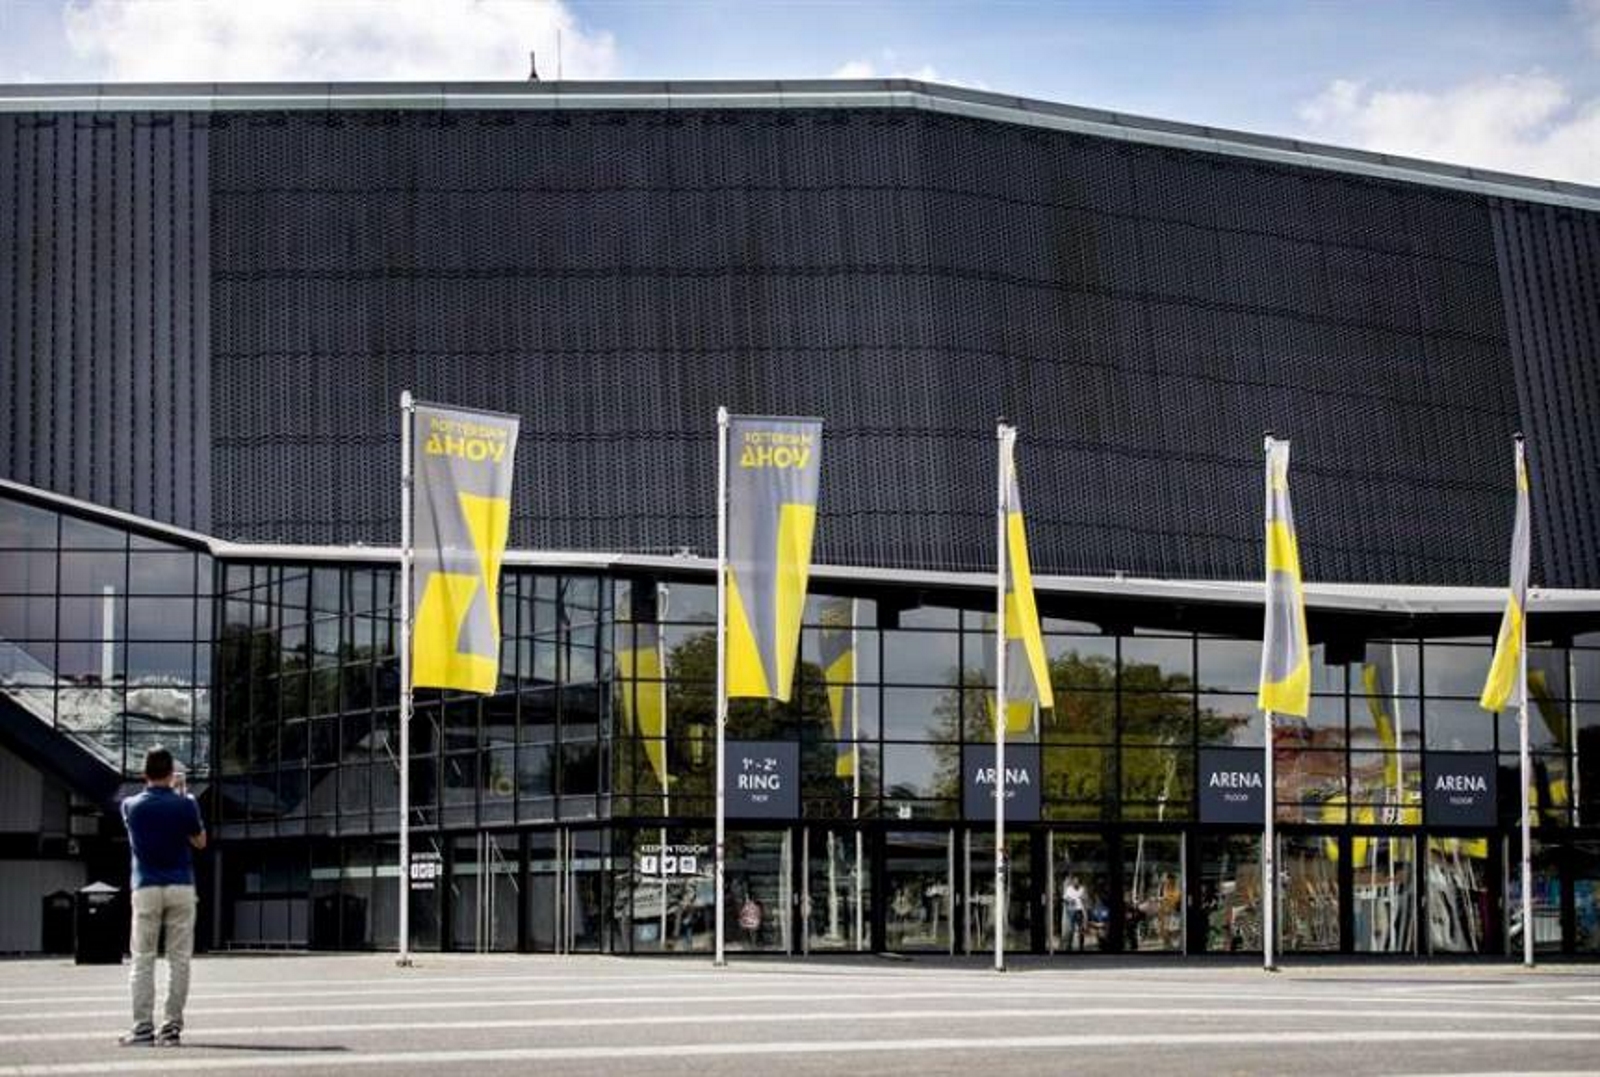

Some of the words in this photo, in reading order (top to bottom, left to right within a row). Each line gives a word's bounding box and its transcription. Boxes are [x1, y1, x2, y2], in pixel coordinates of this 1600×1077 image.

[426, 433, 506, 462] AHOY
[741, 446, 810, 468] AHOY
[738, 773, 780, 790] RING
[975, 767, 1030, 784] ARNA
[1209, 772, 1263, 788] ARENA
[1434, 774, 1487, 791] ARENA
